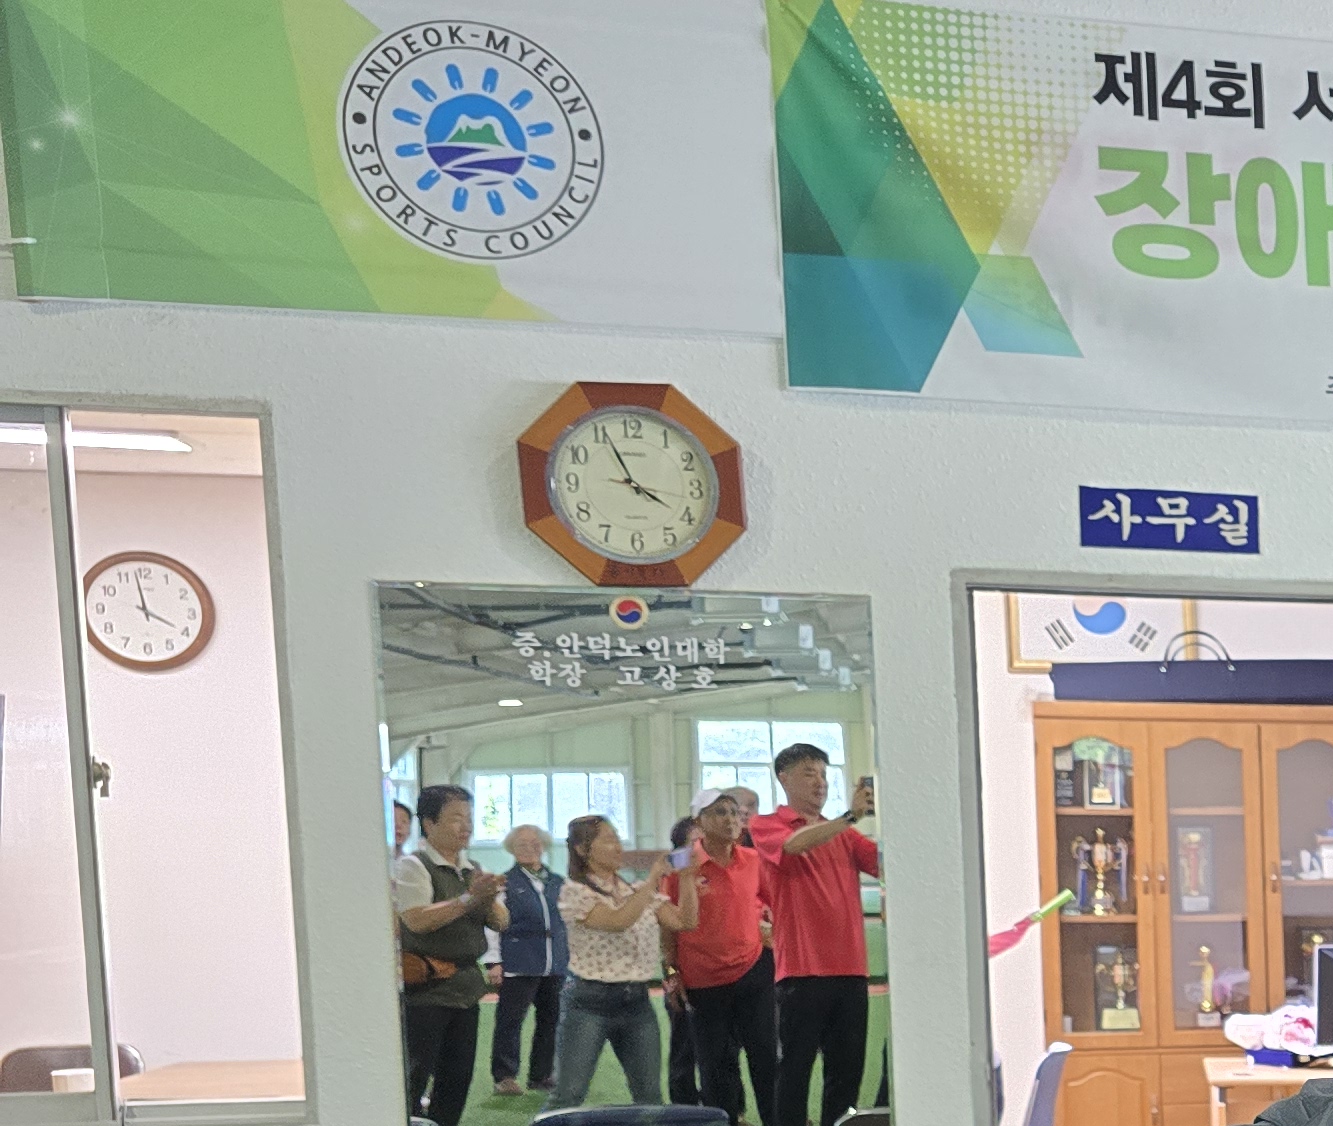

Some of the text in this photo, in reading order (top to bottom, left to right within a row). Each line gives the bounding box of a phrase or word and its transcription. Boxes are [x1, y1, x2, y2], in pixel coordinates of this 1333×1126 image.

[358, 23, 587, 115] ANDEOK-MYEON
[1093, 51, 1265, 129] 제4회
[351, 141, 600, 255] SPORTS COUNCIL
[623, 419, 643, 440] 12
[660, 428, 670, 449] 1
[569, 443, 588, 465] 10
[681, 451, 694, 472] 2
[566, 472, 579, 494] 9
[689, 478, 704, 500] 3
[576, 501, 591, 522] 8
[680, 506, 696, 526] 4
[1087, 492, 1249, 547] 사무실
[599, 524, 612, 545] 7
[631, 532, 644, 552] 6
[663, 527, 677, 547] 5
[117, 571, 130, 584] 11
[137, 567, 152, 580] 12
[163, 573, 170, 585] 1
[102, 585, 117, 597] 10
[179, 588, 189, 601] 2
[95, 603, 105, 615] 9
[187, 608, 197, 620] 3
[104, 622, 114, 635] 8
[180, 626, 190, 638] 4
[121, 637, 130, 649] 7
[143, 642, 153, 655] 6
[165, 638, 175, 651] 5
[527, 661, 587, 688] 학장
